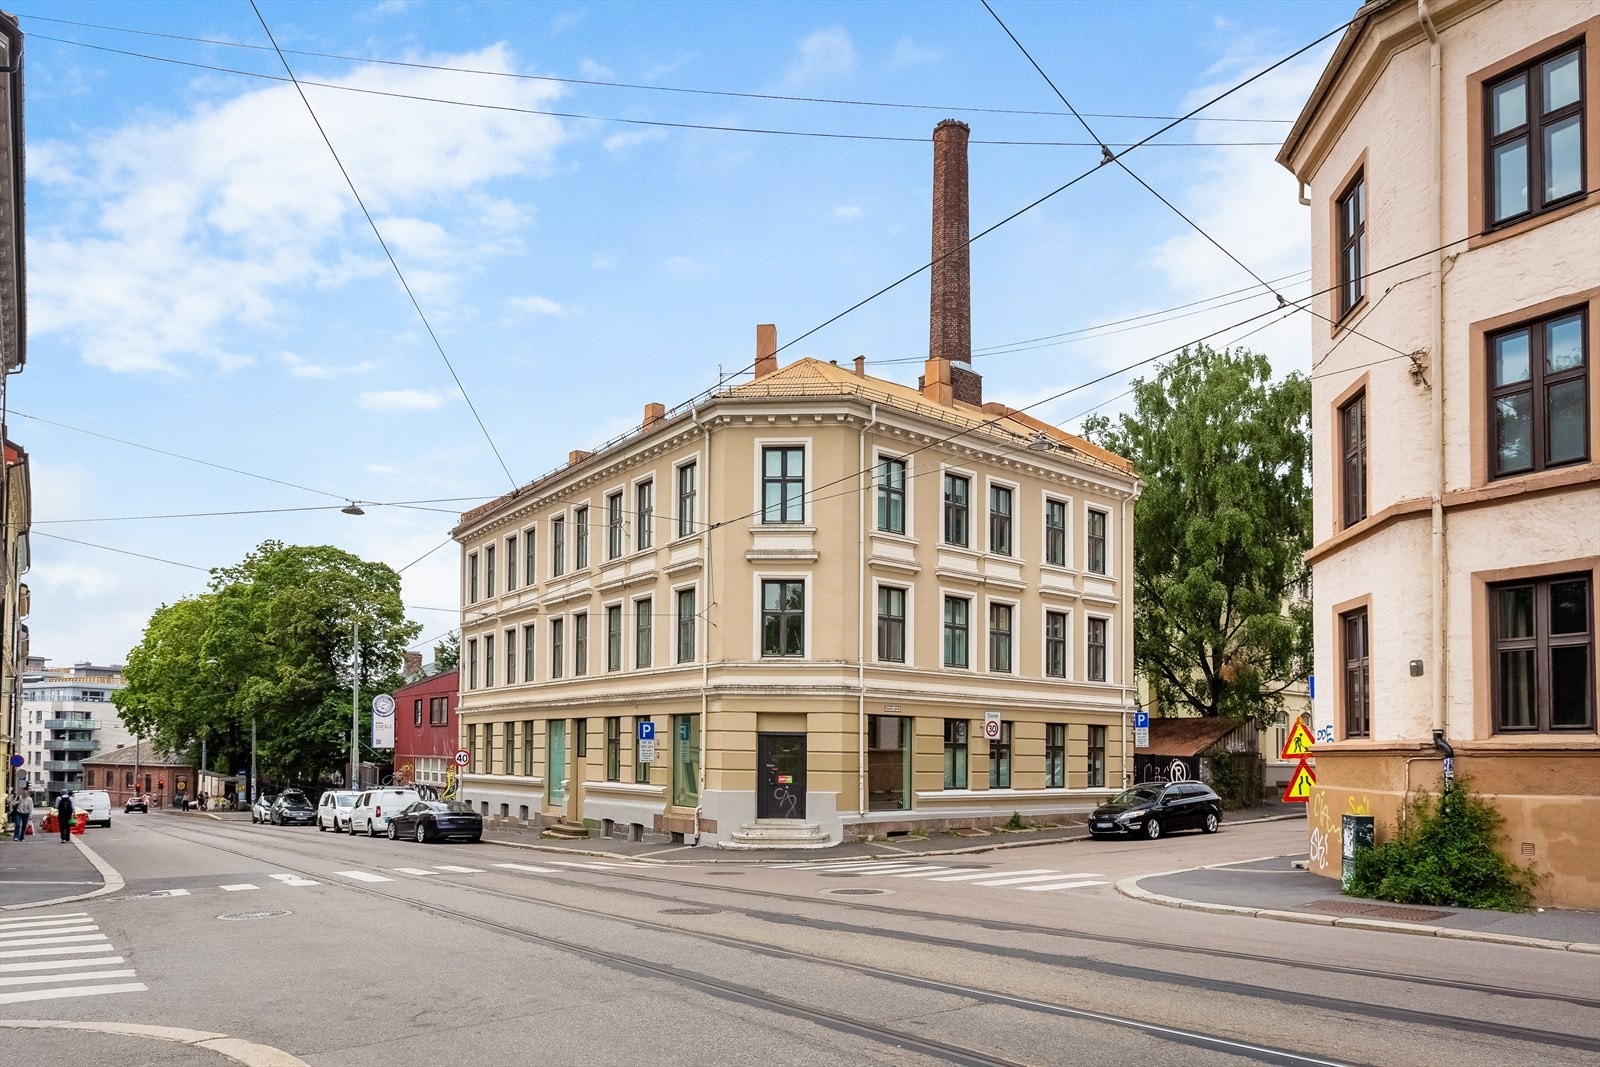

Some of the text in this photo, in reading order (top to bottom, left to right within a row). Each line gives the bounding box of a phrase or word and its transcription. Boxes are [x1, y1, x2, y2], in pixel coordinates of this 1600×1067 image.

[1138, 714, 1146, 726] P
[642, 724, 651, 738] P
[988, 725, 997, 733] 30
[456, 754, 468, 763] 40
